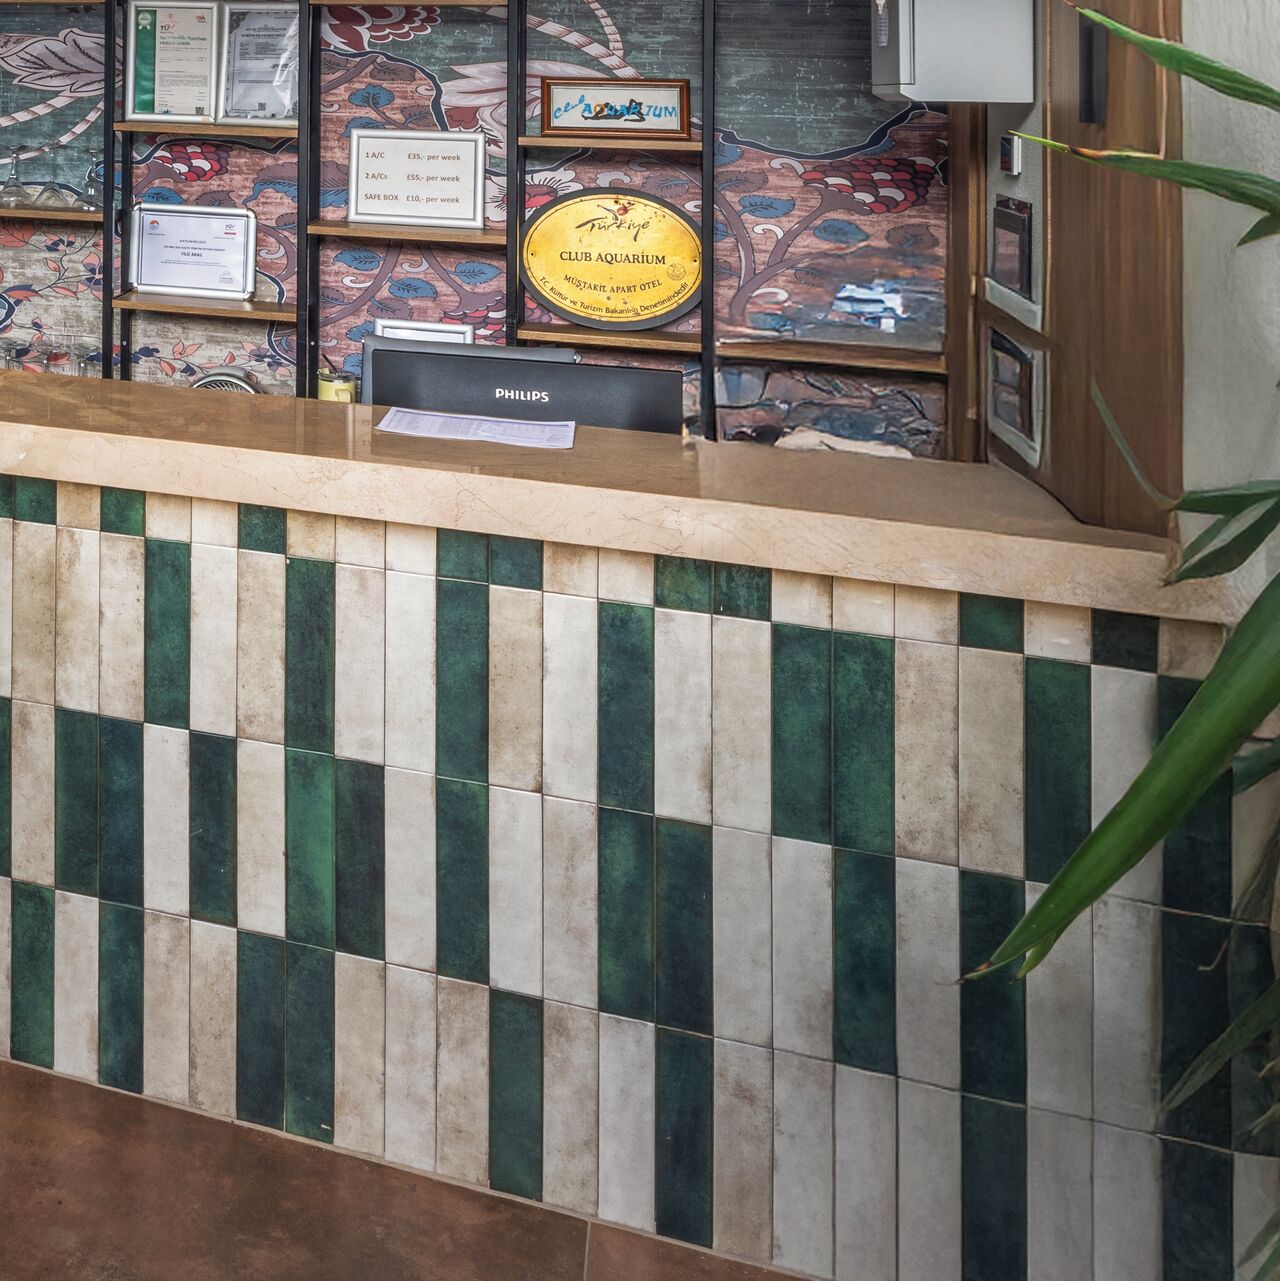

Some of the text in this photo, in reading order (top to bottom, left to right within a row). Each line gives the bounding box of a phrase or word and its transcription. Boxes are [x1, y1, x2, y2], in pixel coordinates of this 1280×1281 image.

[371, 151, 385, 159] A/C
[440, 153, 461, 161] week
[365, 172, 370, 180] 2
[371, 172, 388, 180] A/Cs
[364, 193, 382, 201] SAFE
[440, 195, 460, 203] week
[575, 214, 651, 242] Türkiye
[559, 250, 592, 262] CLUB
[609, 284, 638, 294] APART
[639, 278, 663, 292] OTEL
[549, 286, 569, 302] Kültür
[569, 297, 578, 306] ve
[579, 301, 604, 313] Turizm
[495, 388, 550, 402] PHILIPS
